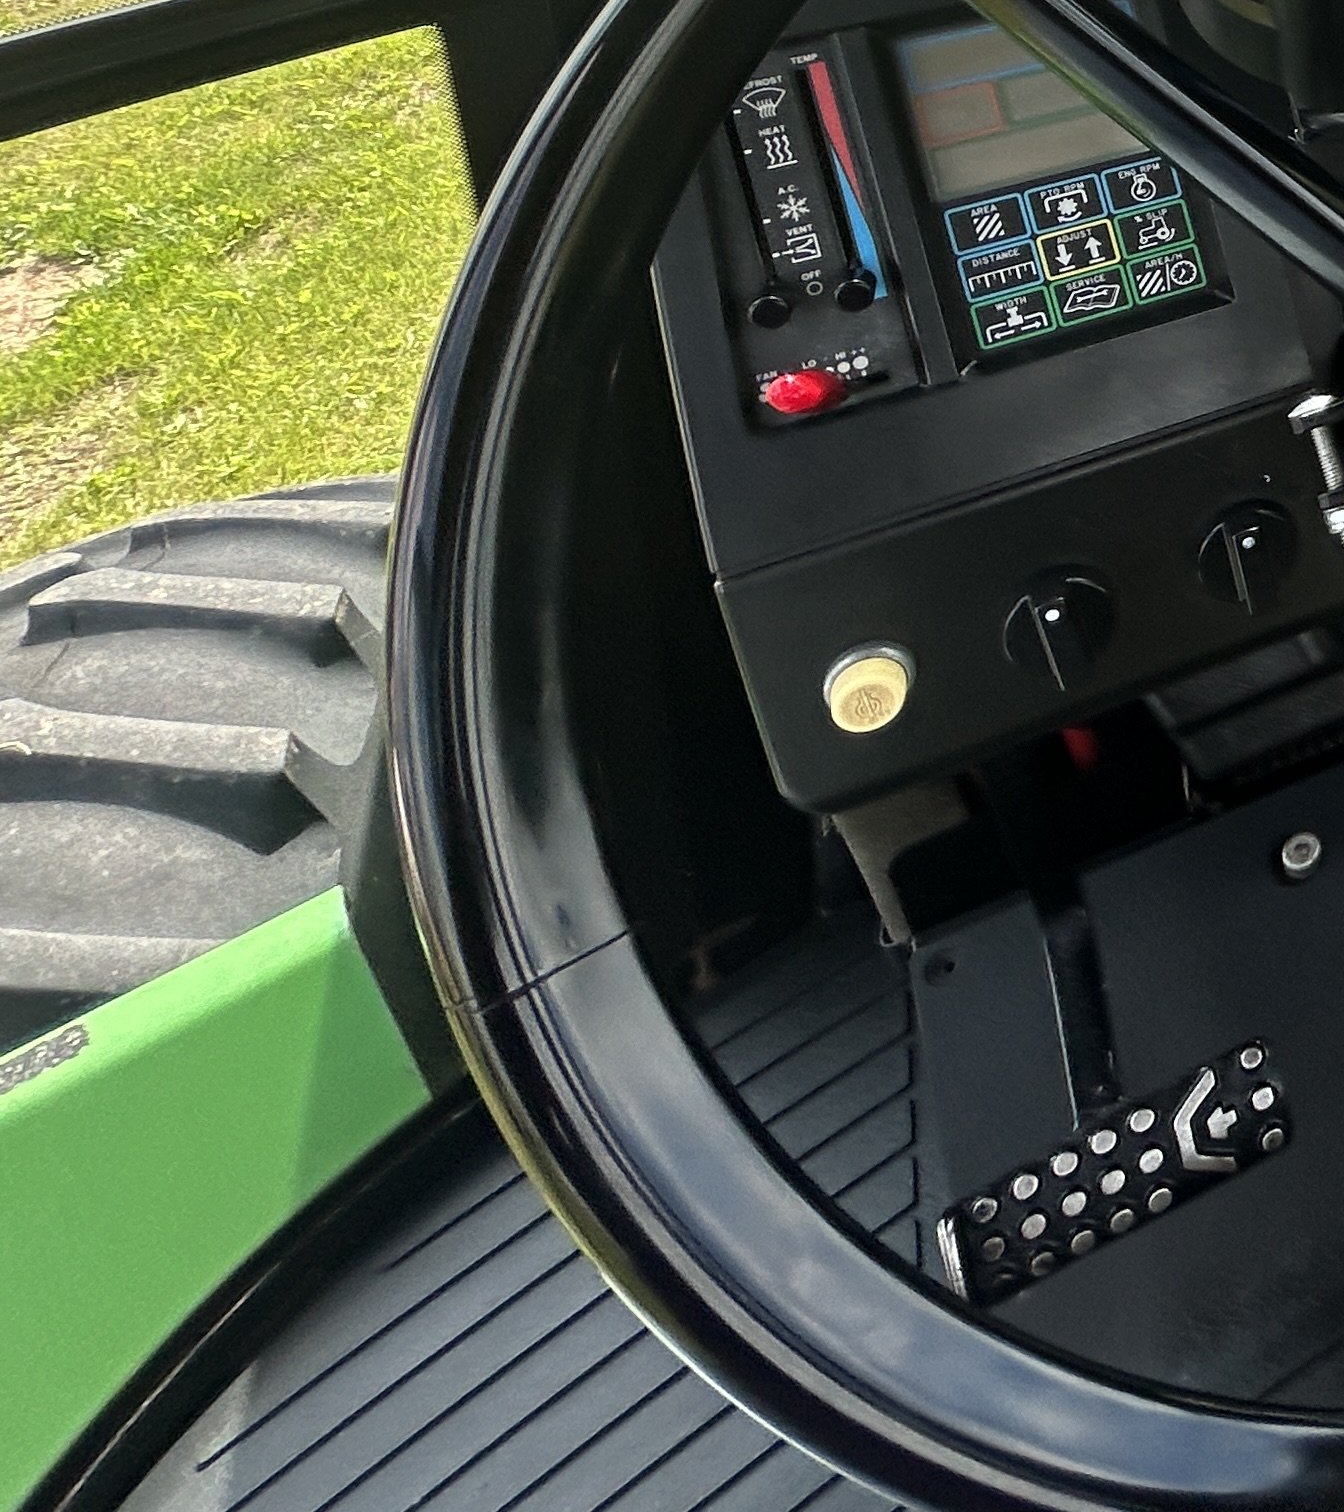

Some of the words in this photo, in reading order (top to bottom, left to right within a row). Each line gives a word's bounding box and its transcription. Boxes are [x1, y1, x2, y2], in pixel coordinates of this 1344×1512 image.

[790, 53, 818, 65] TEMP
[744, 75, 782, 90] FROST
[758, 125, 785, 136] HEAT
[1118, 168, 1136, 180] ENG
[1139, 162, 1161, 174] RPM
[1040, 188, 1060, 199] PTO
[1064, 181, 1085, 193] RPM
[971, 204, 998, 217] AREA
[1146, 208, 1168, 220] SLIP
[785, 224, 813, 236] VENT
[1057, 229, 1092, 244] ADJUST
[972, 248, 1021, 268] DISTANCE
[1145, 252, 1183, 269] AREA/H
[801, 269, 821, 281] OFF
[1066, 274, 1107, 291] SERVICE
[995, 296, 1027, 310] WIDTH
[835, 351, 846, 361] HI
[802, 359, 817, 369] LO
[756, 370, 778, 382] FAN
